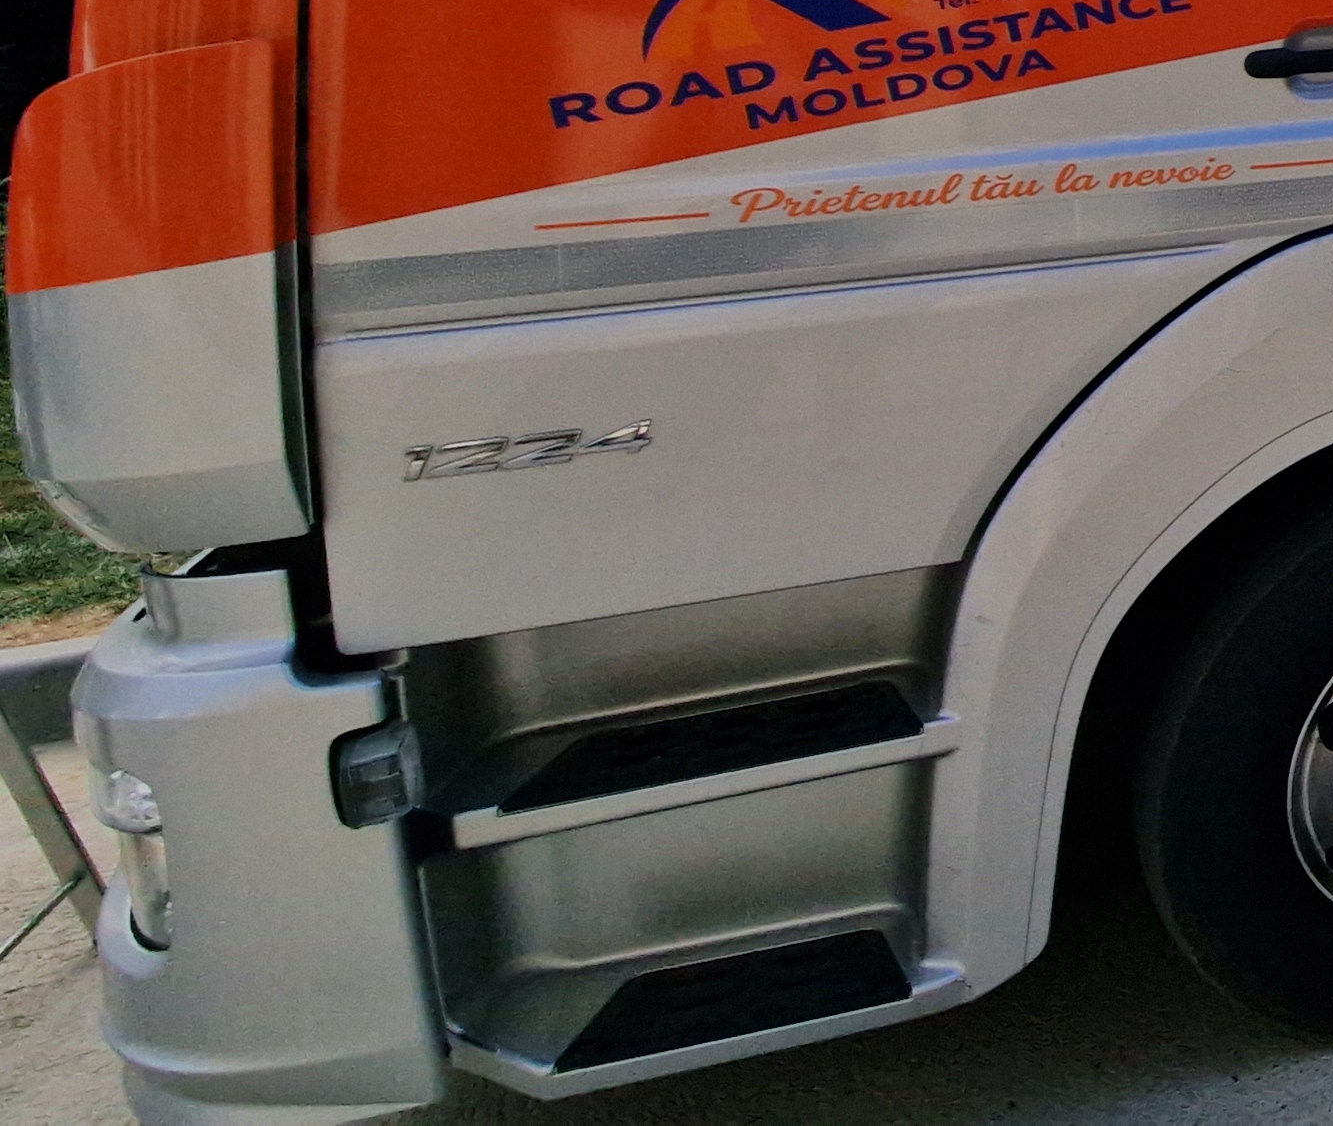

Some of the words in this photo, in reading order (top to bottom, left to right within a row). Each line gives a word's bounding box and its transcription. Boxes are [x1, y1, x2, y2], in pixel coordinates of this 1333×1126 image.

[548, 60, 776, 129] ROAD
[744, 48, 1056, 130] MOLDOVA
[730, 173, 961, 223] Prietenul
[968, 174, 1045, 202] tău
[1053, 162, 1102, 195] la
[1108, 157, 1237, 190] nevoie
[402, 418, 652, 483] 1224
